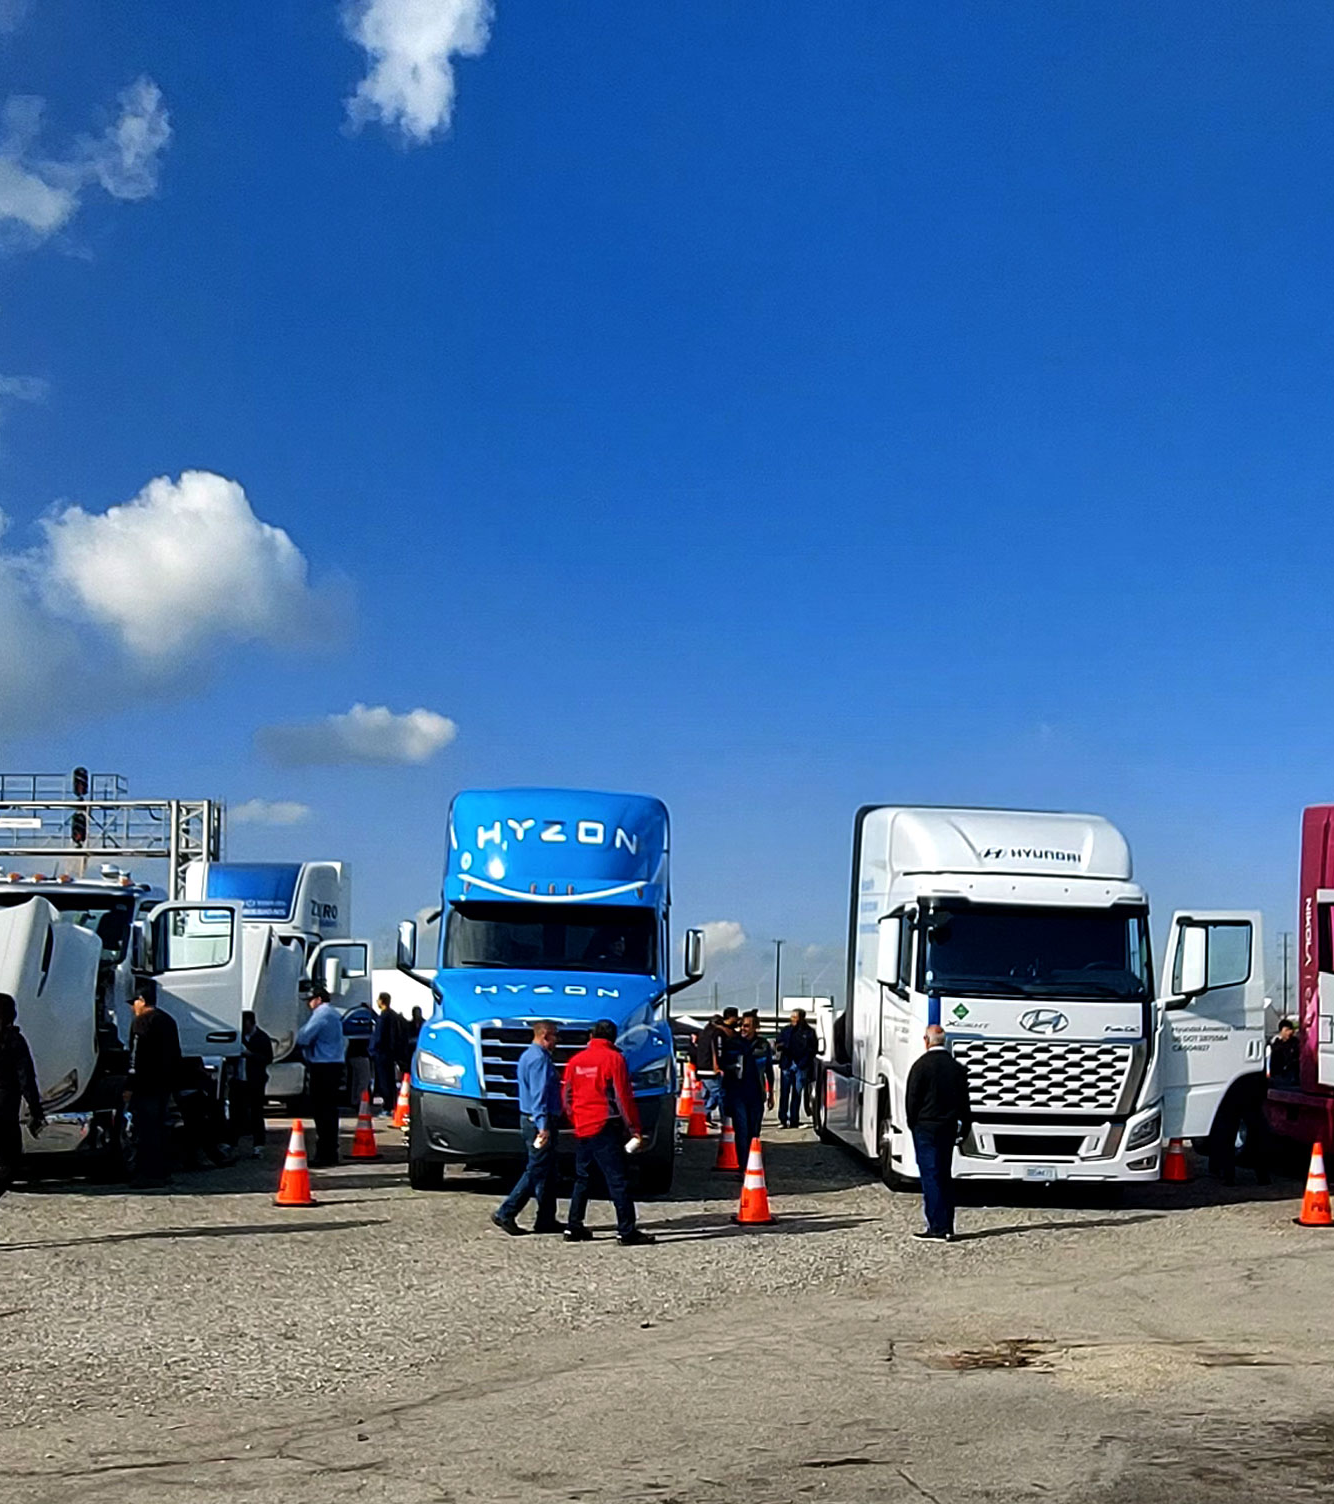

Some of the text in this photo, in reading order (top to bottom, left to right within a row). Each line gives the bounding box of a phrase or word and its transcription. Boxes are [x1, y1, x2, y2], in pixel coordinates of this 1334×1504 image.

[477, 817, 637, 855] HYZON
[1010, 848, 1081, 863] HYUNDAI
[474, 984, 620, 998] HYZON
